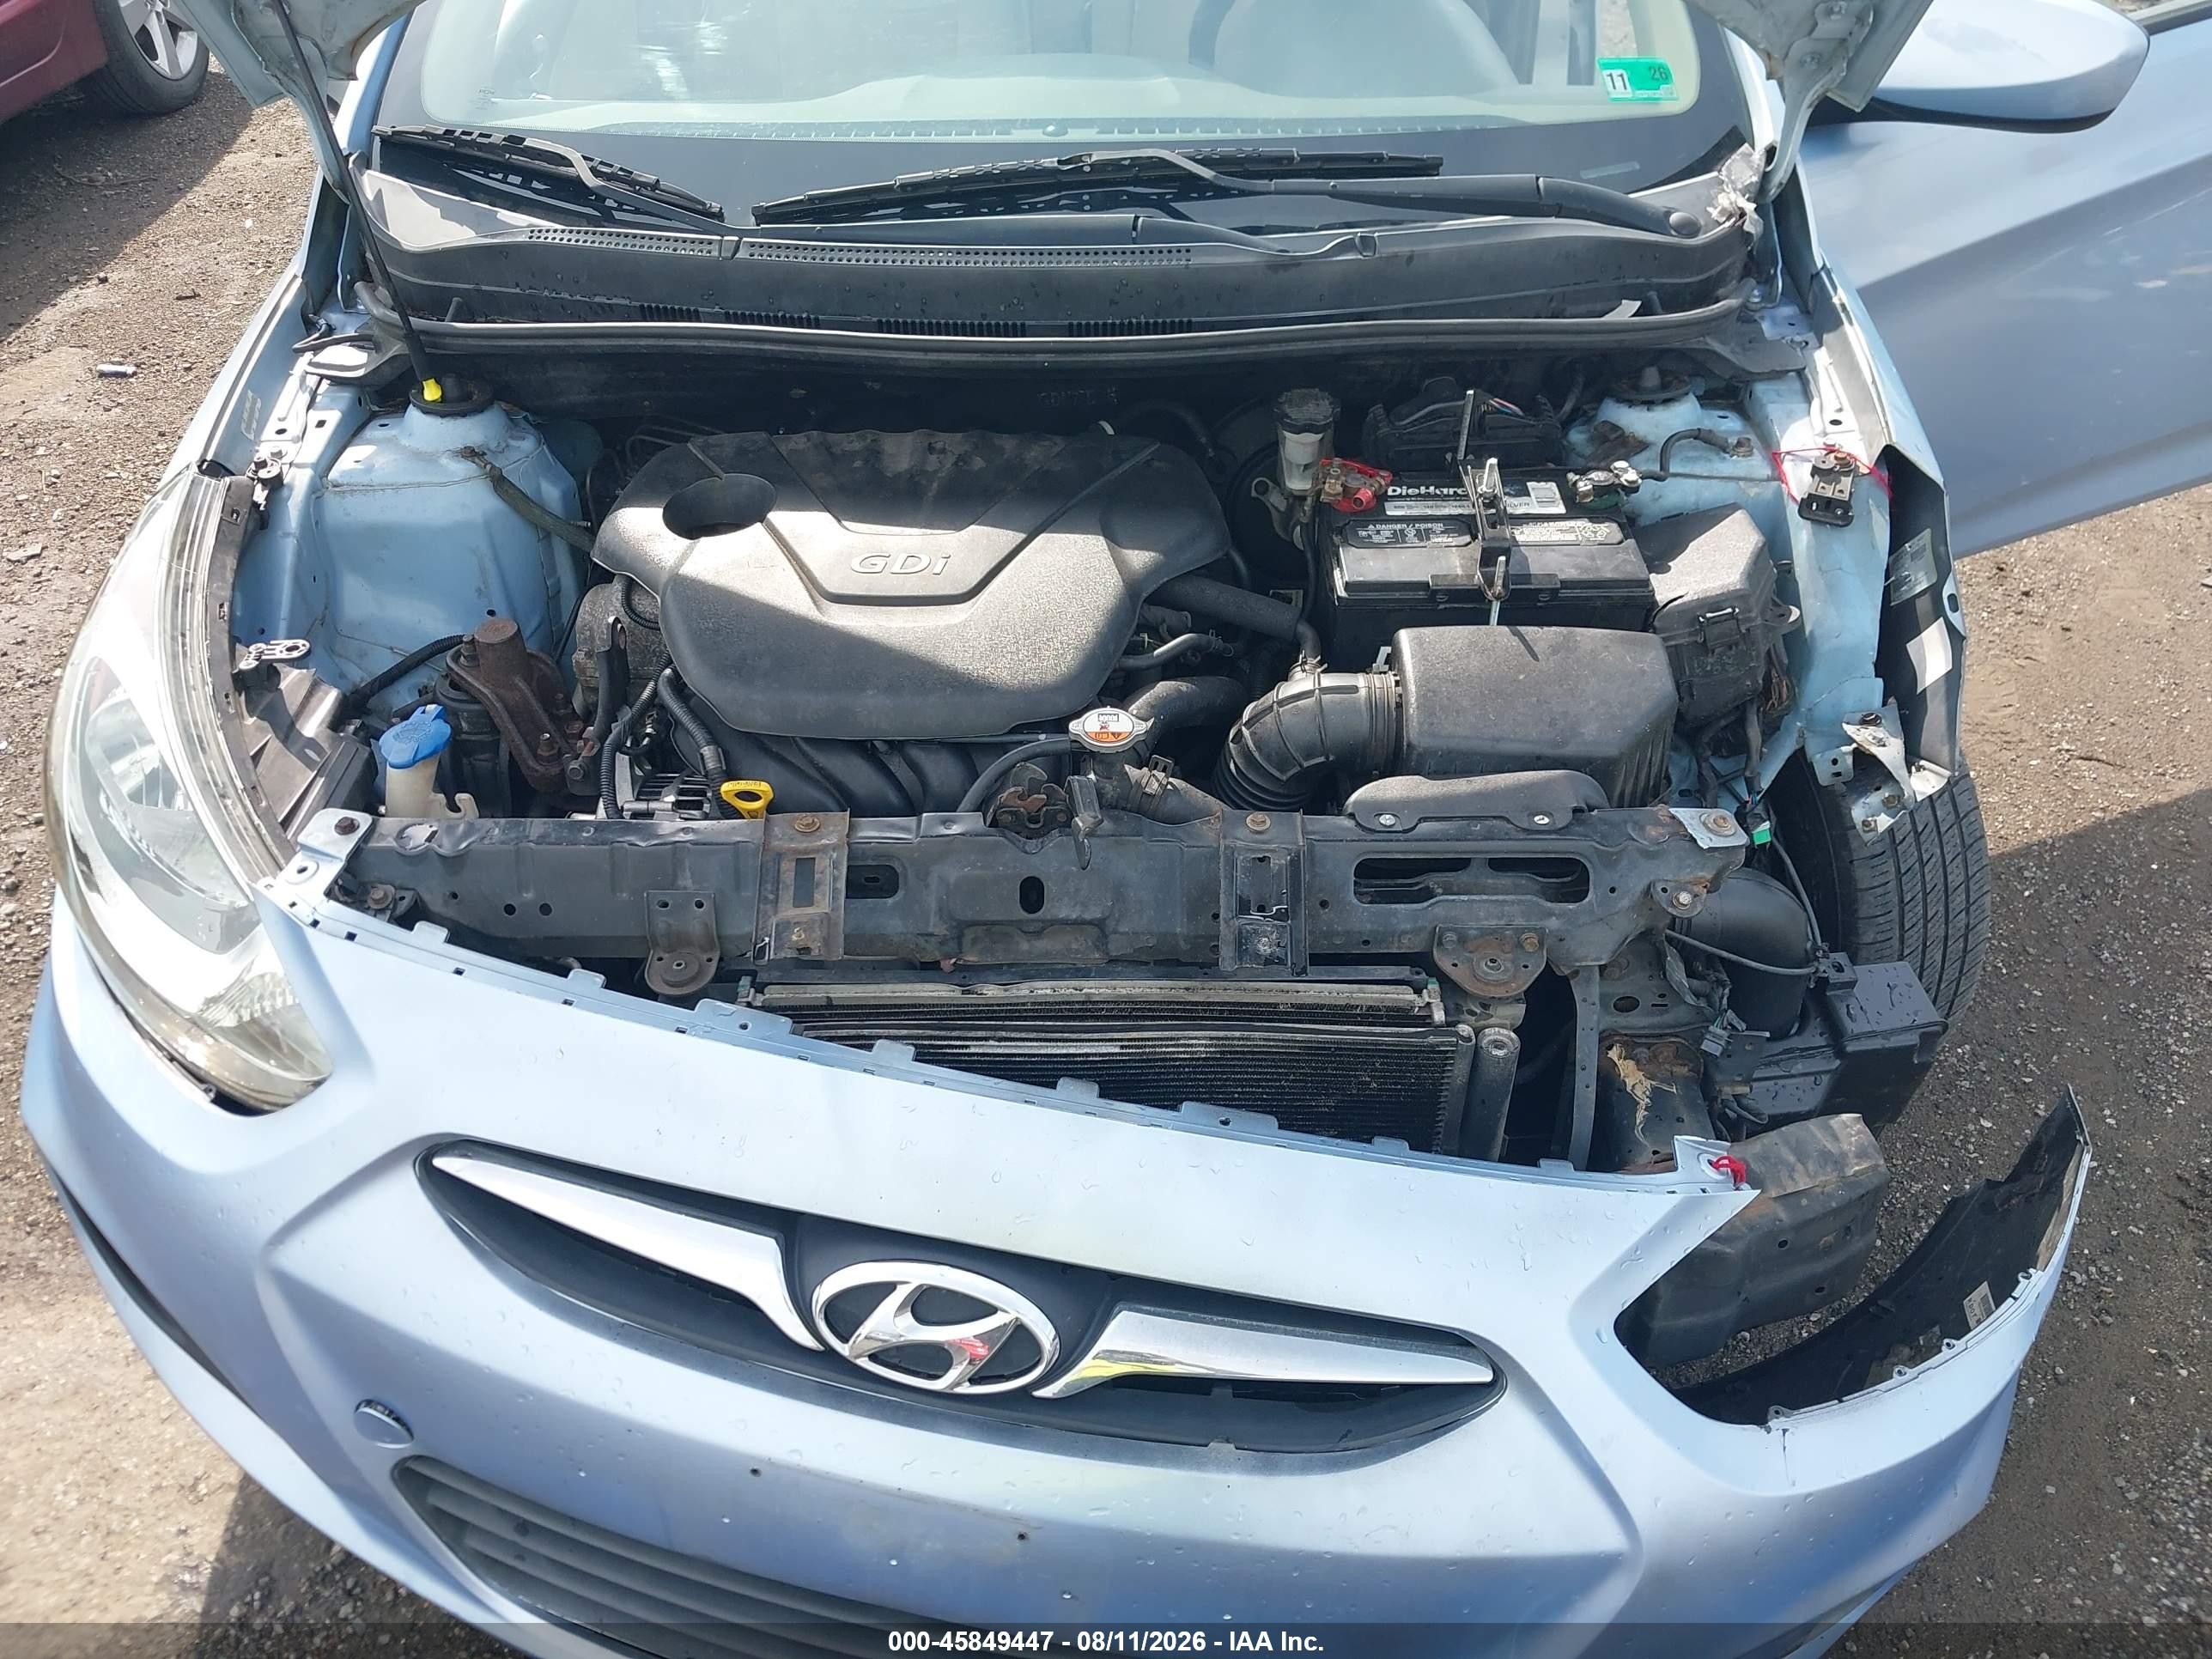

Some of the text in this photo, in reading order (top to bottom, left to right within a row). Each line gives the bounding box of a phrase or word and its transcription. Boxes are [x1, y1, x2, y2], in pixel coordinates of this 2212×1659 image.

[1606, 72, 1627, 90] 11
[1650, 67, 1668, 81] 26
[851, 553, 951, 574] GDi
